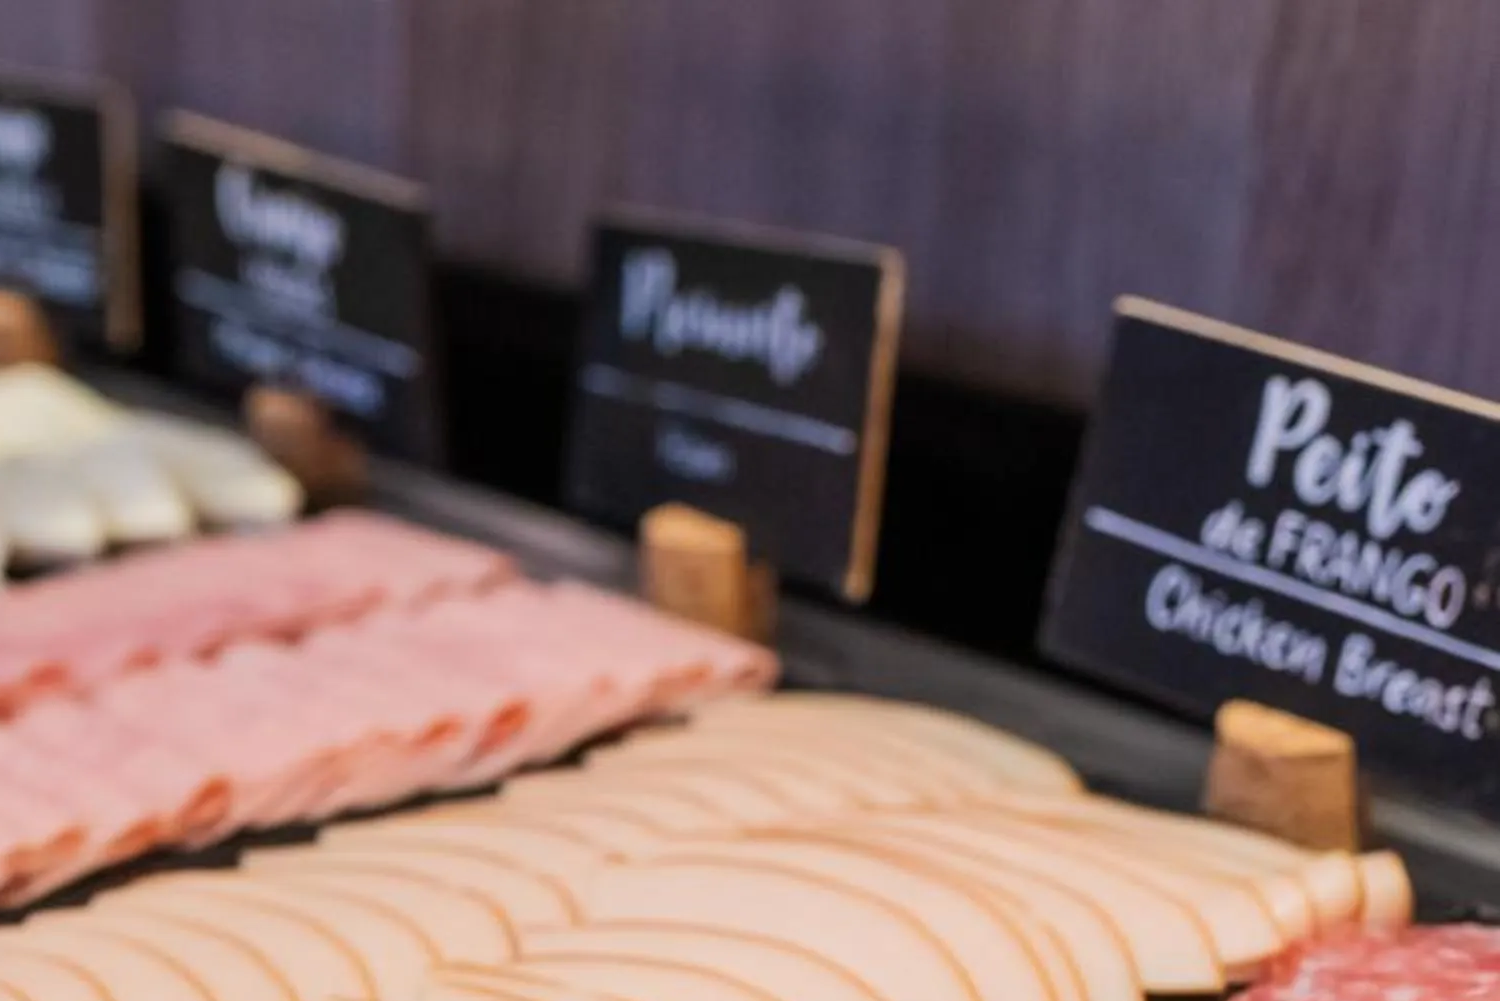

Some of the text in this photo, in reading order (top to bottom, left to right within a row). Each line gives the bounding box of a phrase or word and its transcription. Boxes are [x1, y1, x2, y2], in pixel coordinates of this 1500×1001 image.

[1246, 374, 1460, 538] Peito
[1200, 500, 1466, 629] de FRANGO
[1145, 564, 1495, 740] Chicken Breast
